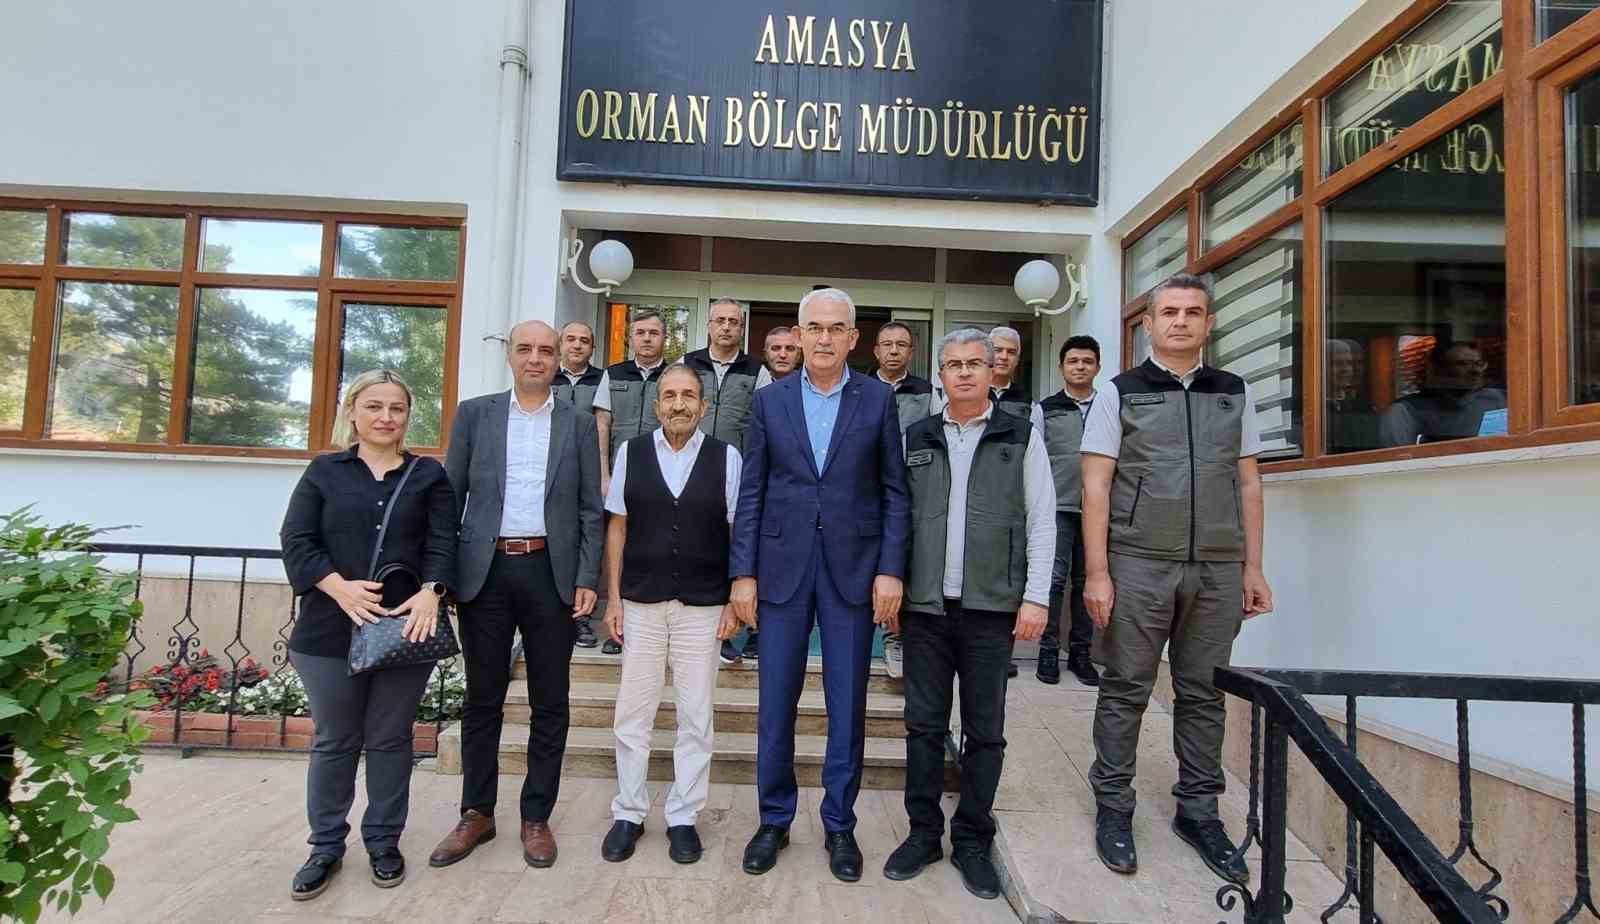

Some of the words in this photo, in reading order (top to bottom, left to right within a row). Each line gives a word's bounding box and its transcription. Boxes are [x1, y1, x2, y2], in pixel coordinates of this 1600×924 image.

[754, 14, 916, 71] AMASYA
[576, 89, 711, 145] ORMAN
[723, 91, 842, 152] BÖLGE
[856, 98, 1089, 163] MÜDÜRLÜĞÜ
